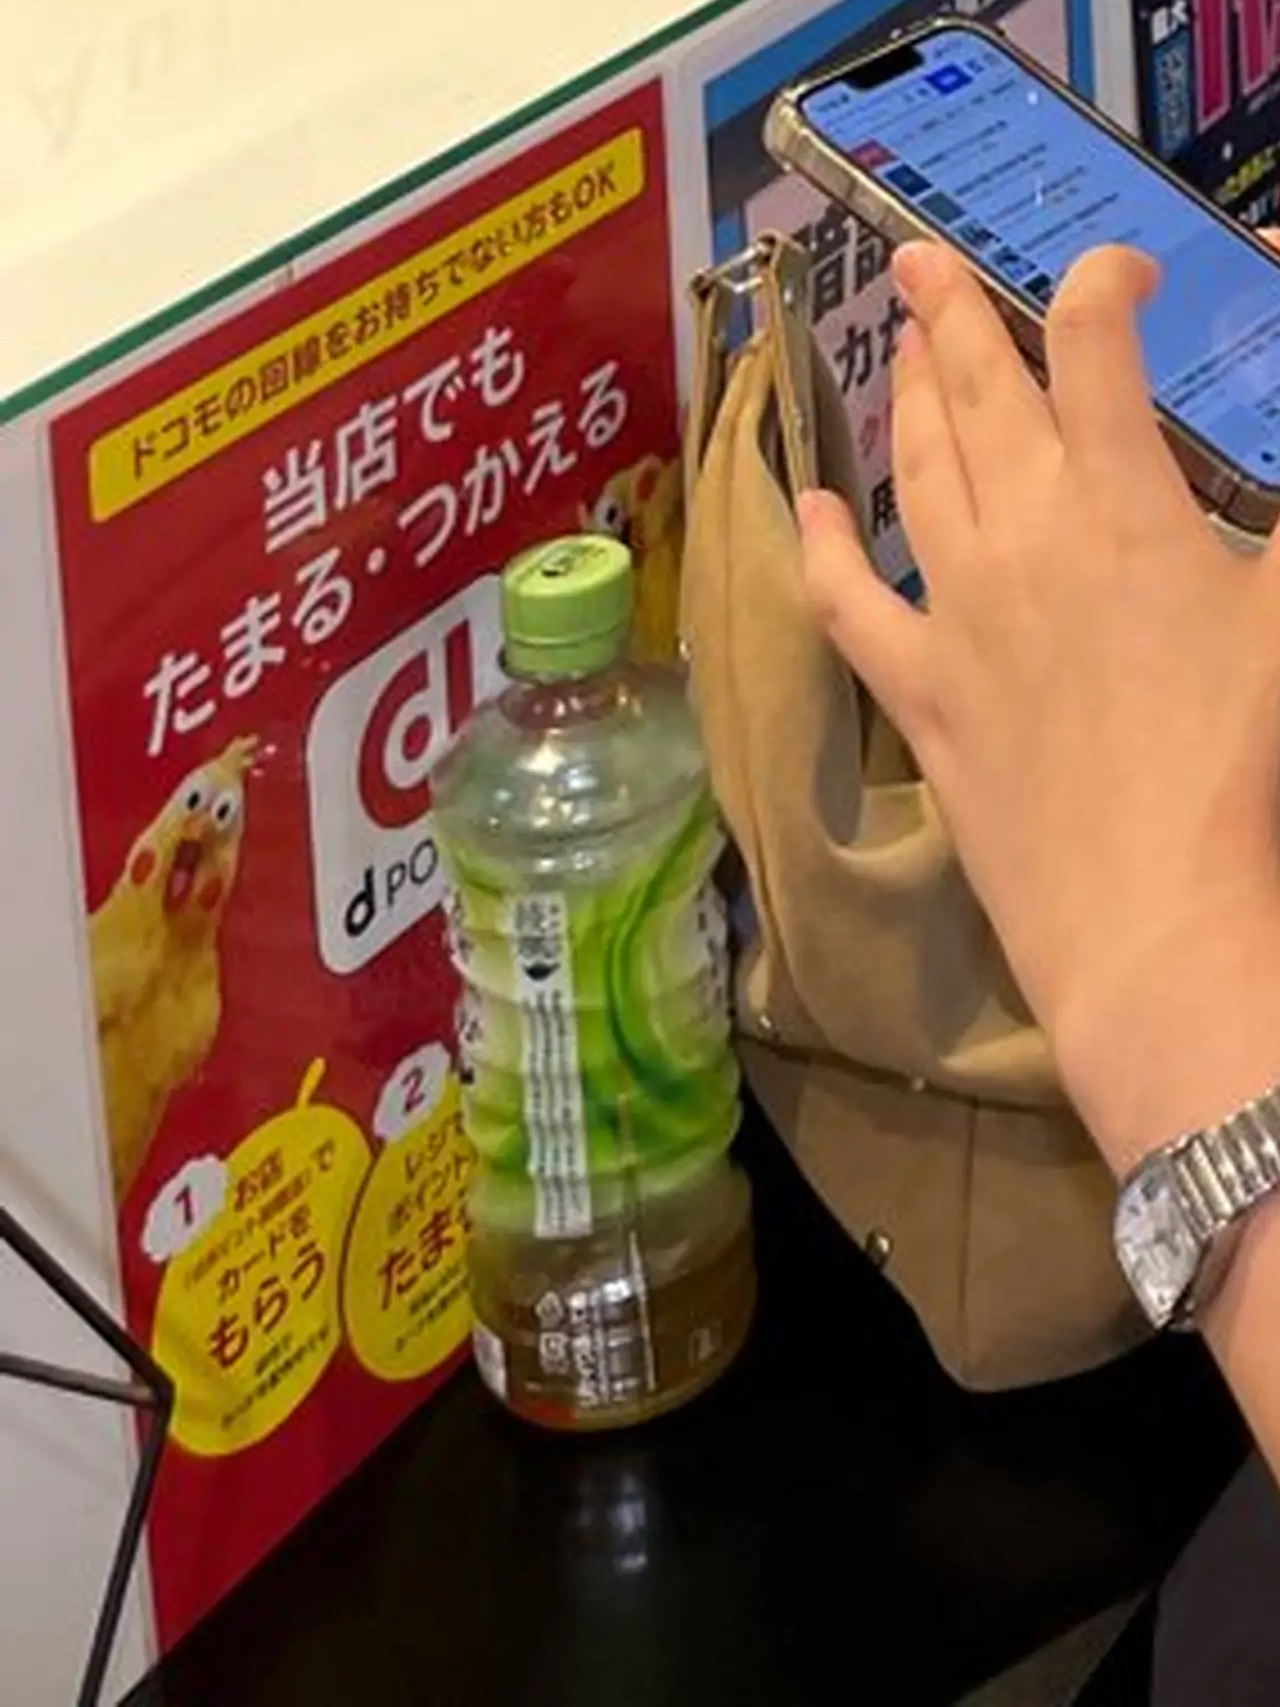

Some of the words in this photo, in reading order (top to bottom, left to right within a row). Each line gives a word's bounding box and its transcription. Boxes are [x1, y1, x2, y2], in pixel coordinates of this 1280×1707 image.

[130, 160, 618, 479] ドコモの回線をお持ちでない方もOK
[262, 326, 525, 553] 当店でも
[144, 360, 627, 757] たまる・つかえる
[386, 838, 439, 906] PO
[401, 1066, 425, 1113] 2
[175, 1185, 194, 1227] 1
[208, 1242, 325, 1371] もらう
